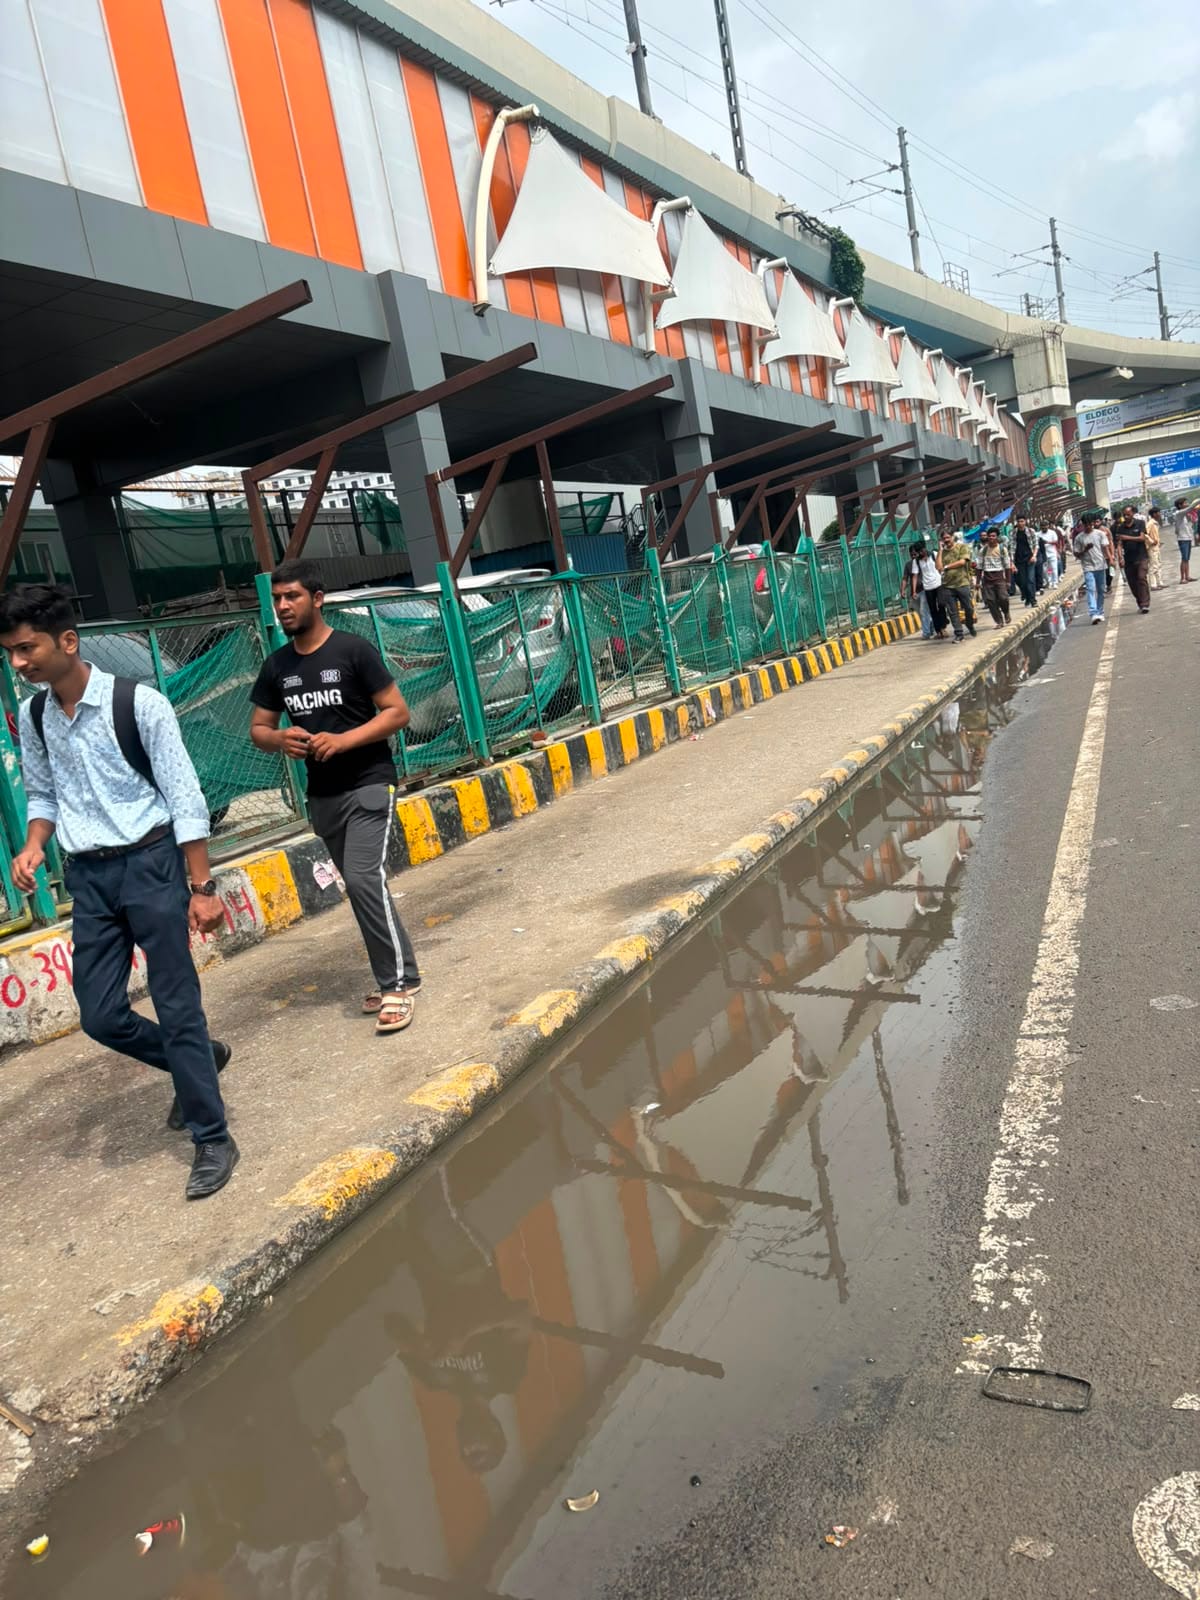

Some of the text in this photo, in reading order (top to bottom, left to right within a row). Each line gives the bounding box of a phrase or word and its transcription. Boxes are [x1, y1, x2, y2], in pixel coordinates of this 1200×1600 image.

[1085, 406, 1120, 421] ELDECO
[1085, 420, 1096, 437] 7
[284, 689, 343, 713] PACING
